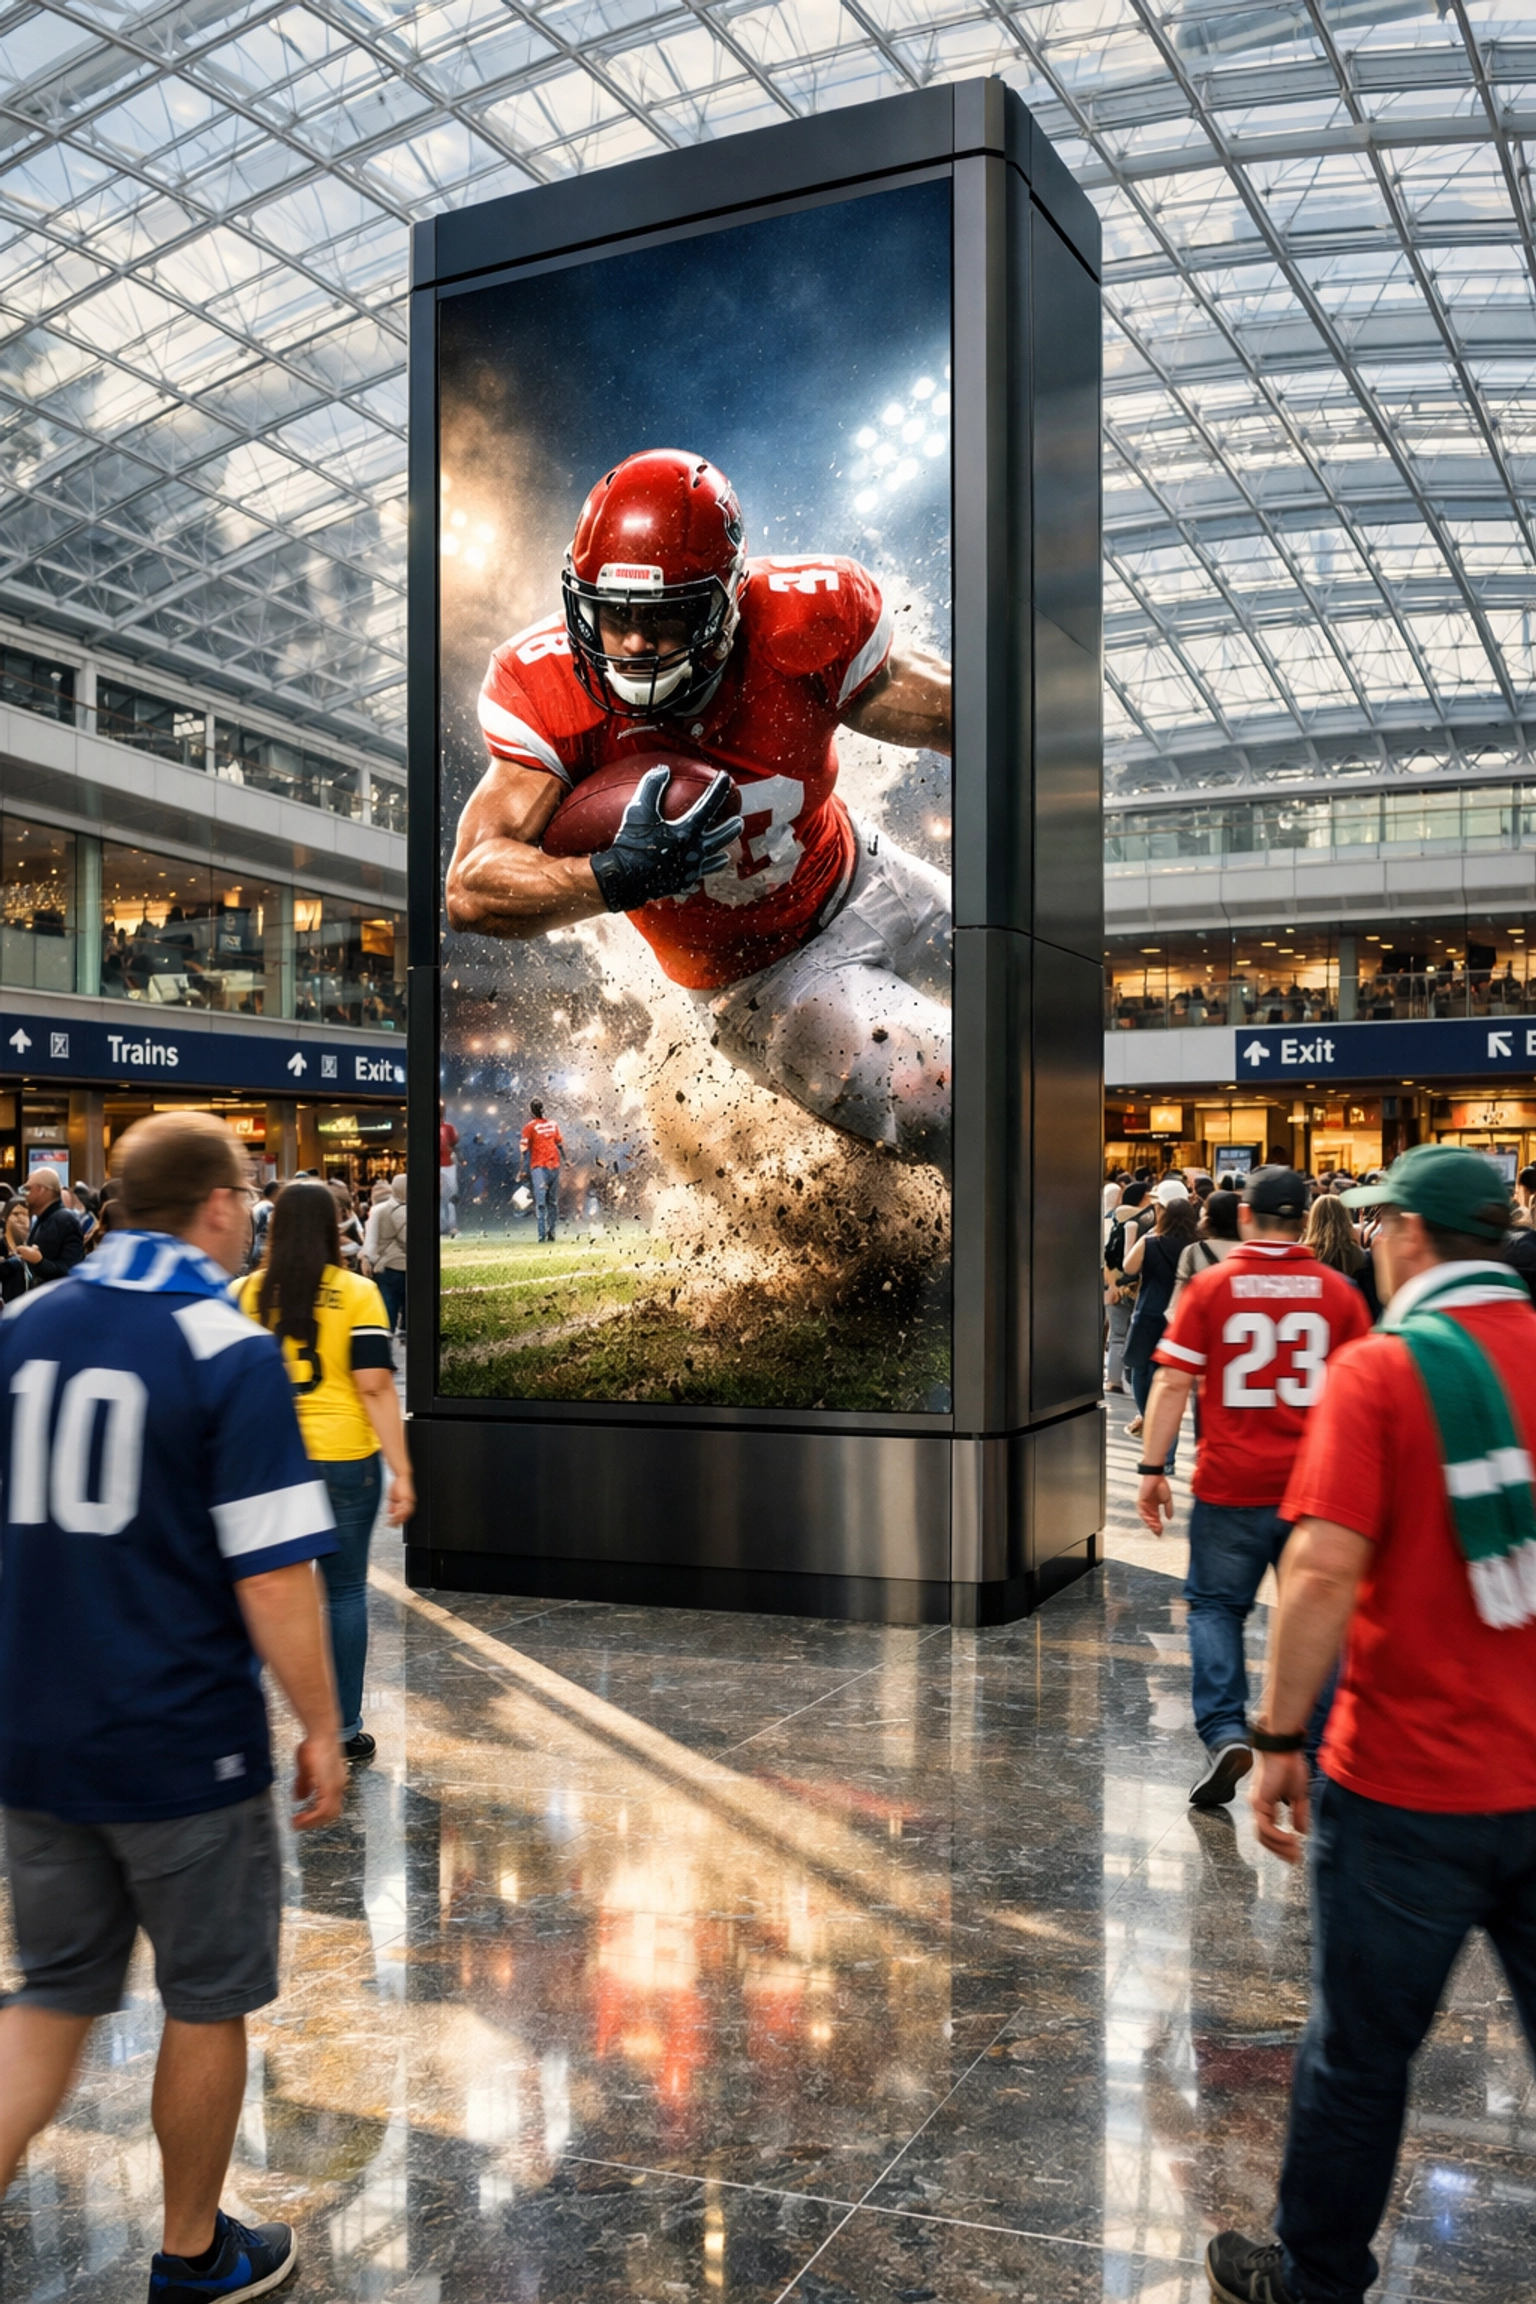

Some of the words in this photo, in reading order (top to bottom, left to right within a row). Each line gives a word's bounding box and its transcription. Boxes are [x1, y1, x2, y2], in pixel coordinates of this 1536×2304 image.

[671, 773, 807, 909] 3
[107, 1035, 179, 1067] Trains
[1281, 1037, 1335, 1065] Exit
[1223, 1312, 1330, 1408] 23
[8, 1358, 149, 1536] 10
